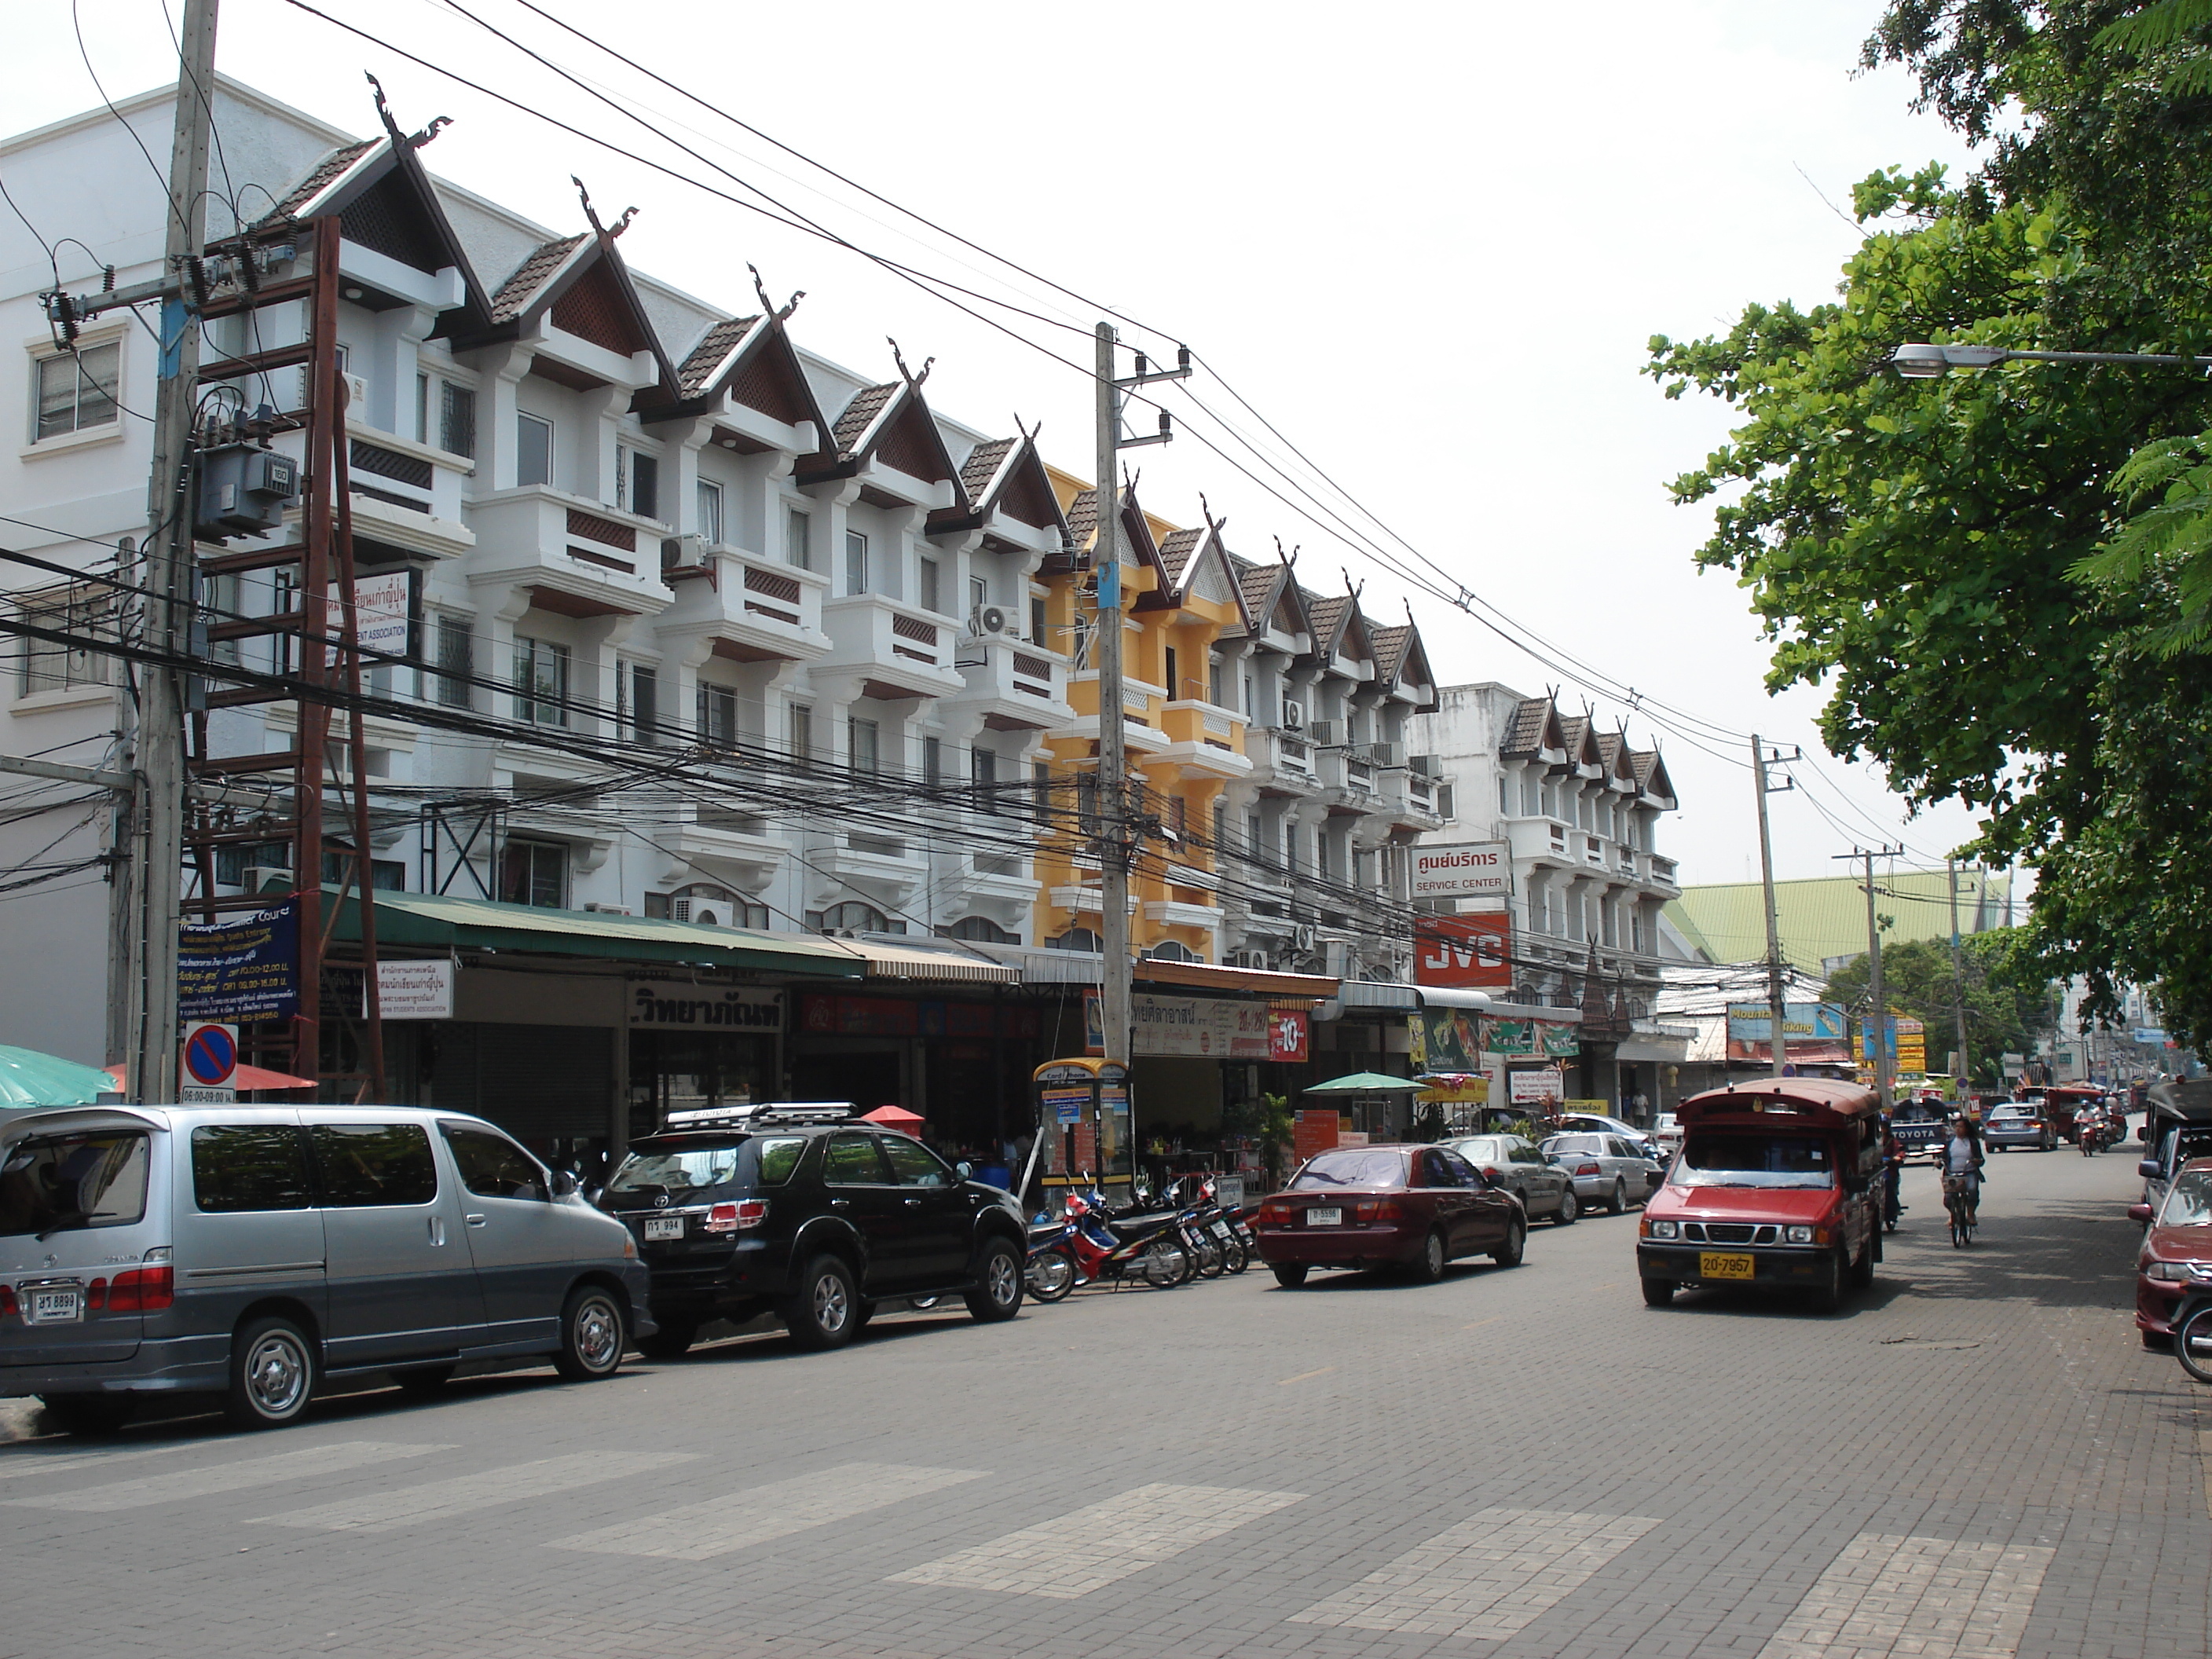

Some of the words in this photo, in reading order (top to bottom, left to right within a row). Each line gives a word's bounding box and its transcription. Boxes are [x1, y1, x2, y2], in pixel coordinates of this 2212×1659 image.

[368, 626, 405, 640] ASSOCIATION
[1419, 852, 1498, 874] ศูนย์บริการ
[1417, 881, 1458, 892] SERVICE
[1463, 878, 1502, 888] CENTER
[1425, 934, 1503, 969] JVC
[1731, 1009, 1773, 1019] Mounta
[1892, 1130, 1935, 1139] TOYOTA
[664, 1221, 678, 1231] 994
[1703, 1258, 1749, 1272] 20-7957
[54, 1295, 74, 1308] 8899
